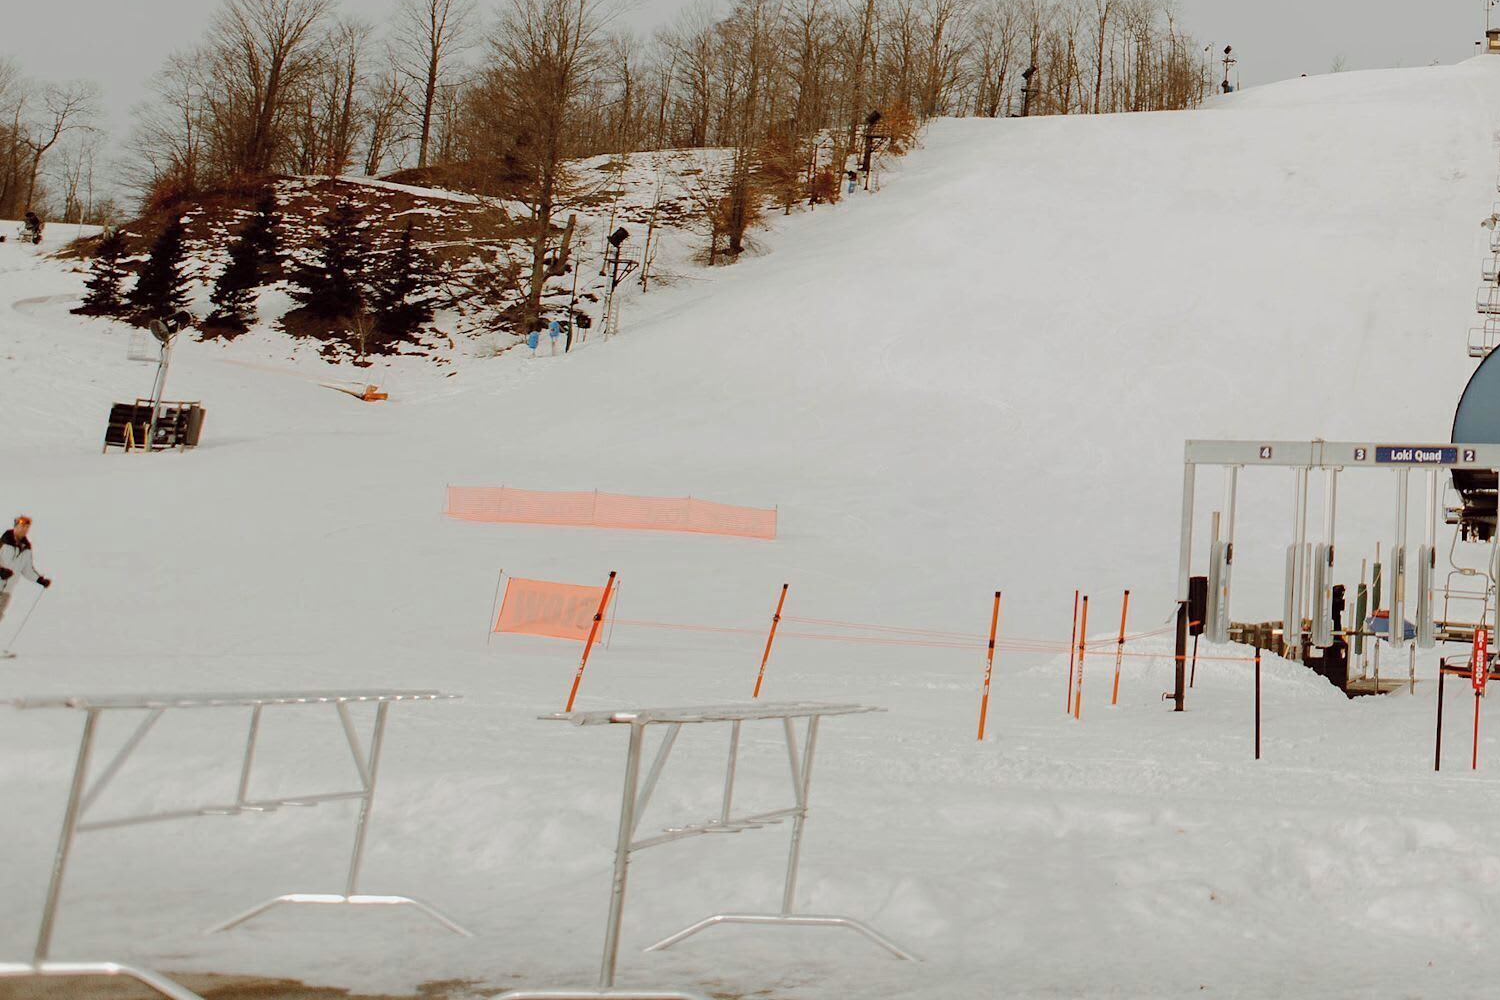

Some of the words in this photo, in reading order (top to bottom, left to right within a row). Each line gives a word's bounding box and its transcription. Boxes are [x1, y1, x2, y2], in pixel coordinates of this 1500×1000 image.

[1261, 447, 1270, 458] 4
[1357, 449, 1365, 460] 3
[1391, 449, 1413, 461] Loki
[1415, 450, 1442, 462] Quad
[1465, 450, 1474, 462] 2
[1475, 649, 1484, 685] SCHOOL
